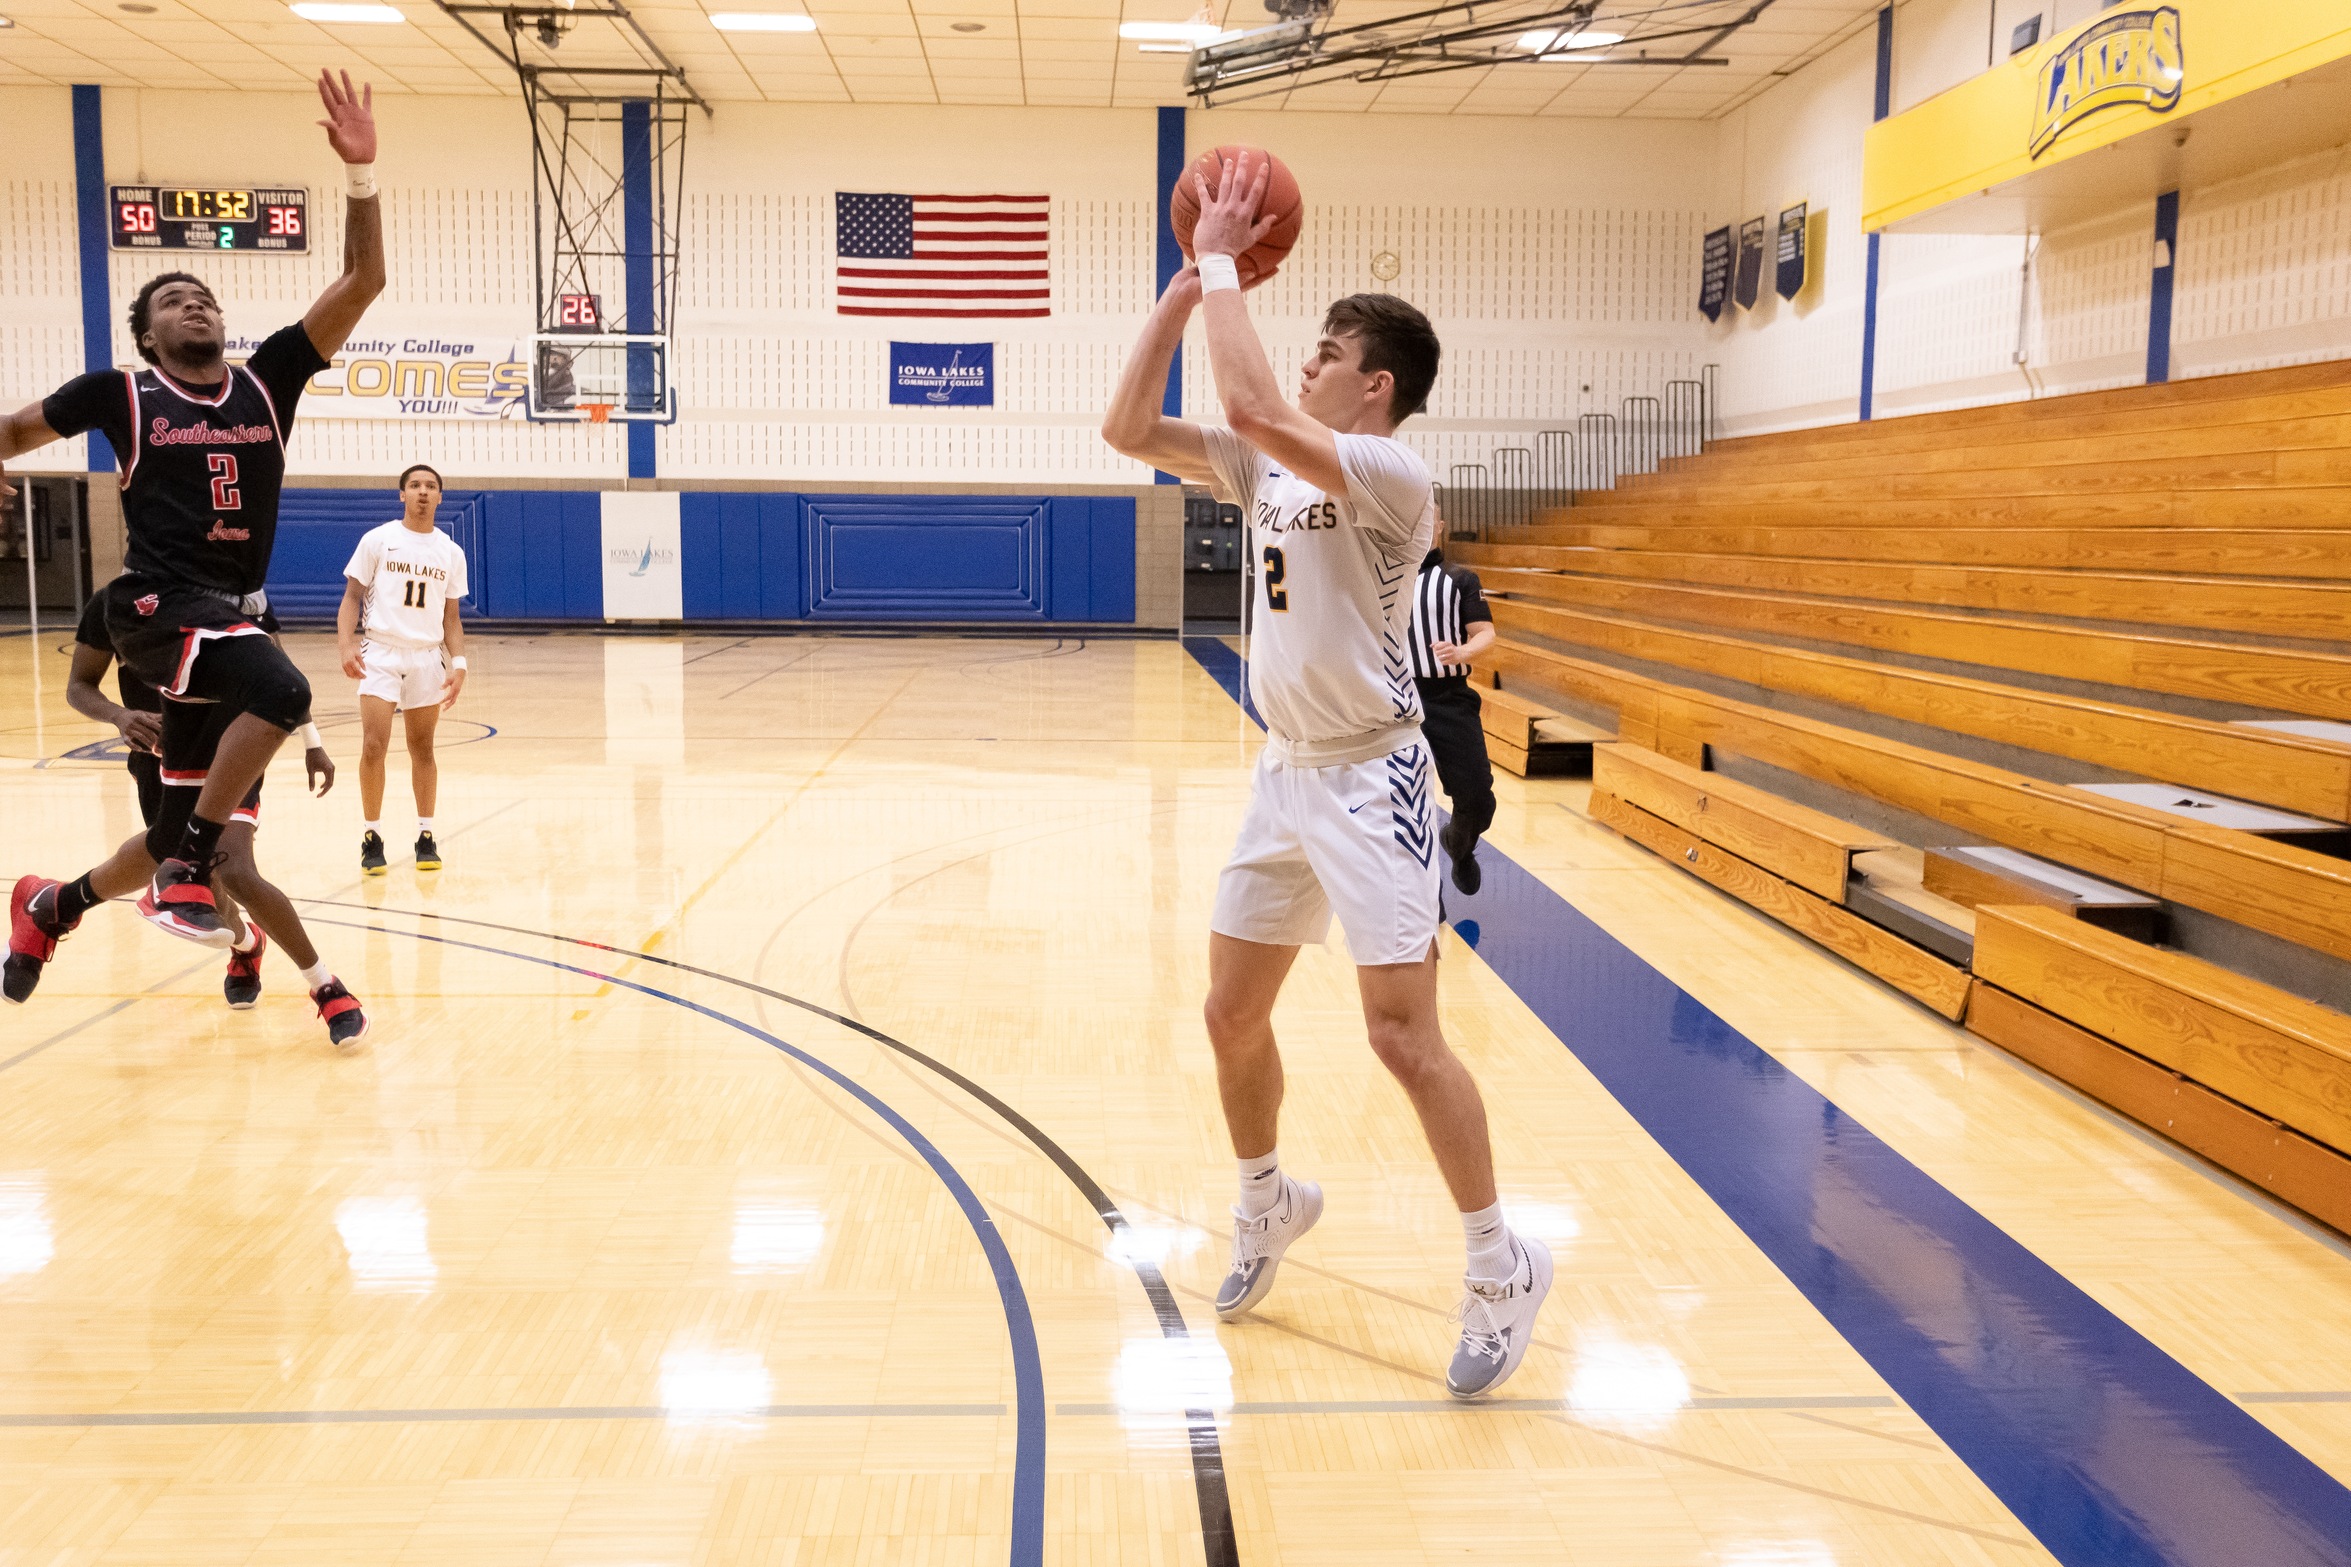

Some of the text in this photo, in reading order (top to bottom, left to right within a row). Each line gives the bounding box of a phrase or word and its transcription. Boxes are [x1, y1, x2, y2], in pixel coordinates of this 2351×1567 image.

[2031, 10, 2182, 145] LAKERS
[117, 189, 152, 202] HOME
[175, 191, 248, 218] 17:52
[258, 192, 304, 205] VISITOR
[121, 204, 155, 232] 50
[268, 207, 300, 234] 36
[132, 235, 162, 246] BONUS
[184, 230, 217, 241] PERIOD
[220, 226, 234, 248] 2
[258, 238, 287, 248] BONUS
[563, 296, 596, 324] 26
[225, 336, 474, 357] ake unity College
[304, 359, 528, 398] COMES
[898, 365, 984, 377] IOWA LAKES
[898, 379, 984, 387] COMMUNITY COLLEGE
[399, 400, 458, 414] YOU!!!
[150, 417, 273, 446] Southeastern
[207, 453, 242, 510] 2
[610, 549, 638, 558] IOWA
[386, 561, 446, 581] IOWA LAKES
[1263, 544, 1289, 613] 2
[404, 580, 426, 608] 11
